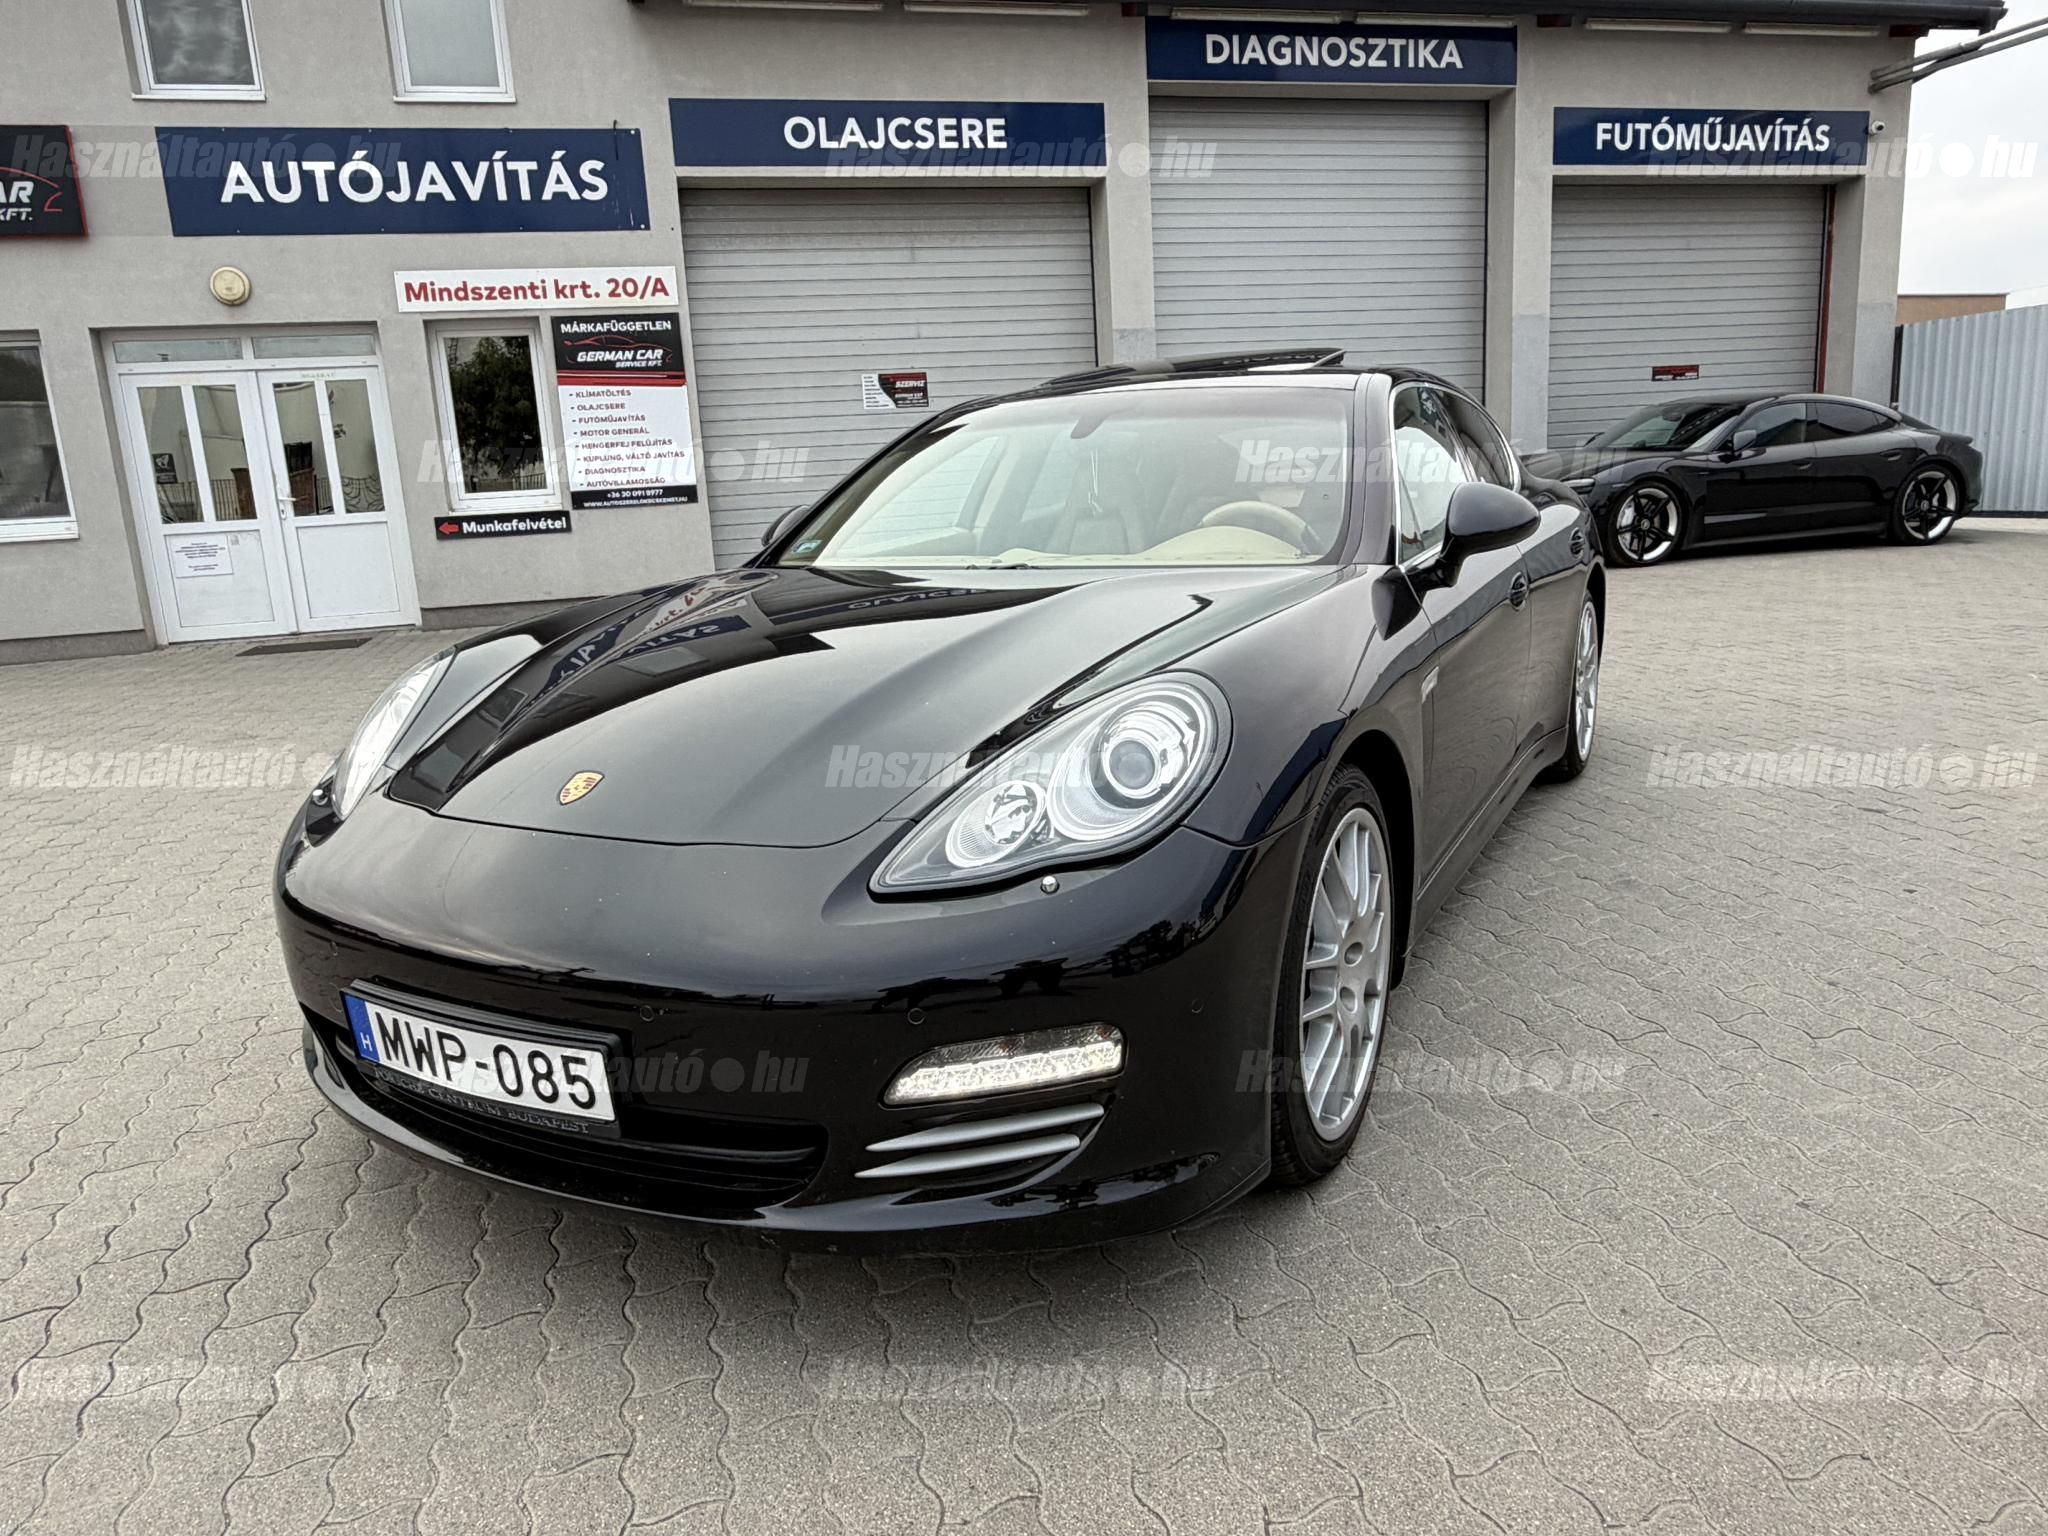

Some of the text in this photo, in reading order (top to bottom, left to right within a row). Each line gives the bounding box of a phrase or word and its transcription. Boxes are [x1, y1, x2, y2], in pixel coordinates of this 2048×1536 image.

[1206, 35, 1464, 69] DIAGNOSZTIKA
[783, 116, 1008, 150] OLAJCSERE
[1596, 116, 1830, 152] FUTÓMŰJAVÍTÁS
[220, 150, 609, 203] AUTÓJAVÍTÁS
[404, 276, 670, 302] Mindszenti krt. 20/A
[560, 320, 672, 333] MÁRKAFÜGGETLEN
[577, 348, 663, 362] GERMAN CAR
[575, 388, 632, 398] KLÍMATÖLTÉS
[577, 403, 626, 411] OLAJCSERE
[578, 413, 646, 424] FUTÓMŰJAVÍTÁS
[580, 426, 650, 437] MOTOR GENERÁL
[581, 441, 630, 449] HENGERFEJ
[583, 450, 685, 463] KUPLUNG, VÁLTÓ JAVÍTÁS
[584, 466, 646, 475] DIAGNOSZTIKA
[586, 476, 666, 487] AUTÓVILLAMOSSÁG
[462, 516, 567, 534] Munkafelvétel
[361, 1032, 371, 1052] H
[375, 1011, 596, 1110] MWP-085
[429, 1088, 501, 1117] CENTRUM
[508, 1111, 590, 1134] BUDAPEST
